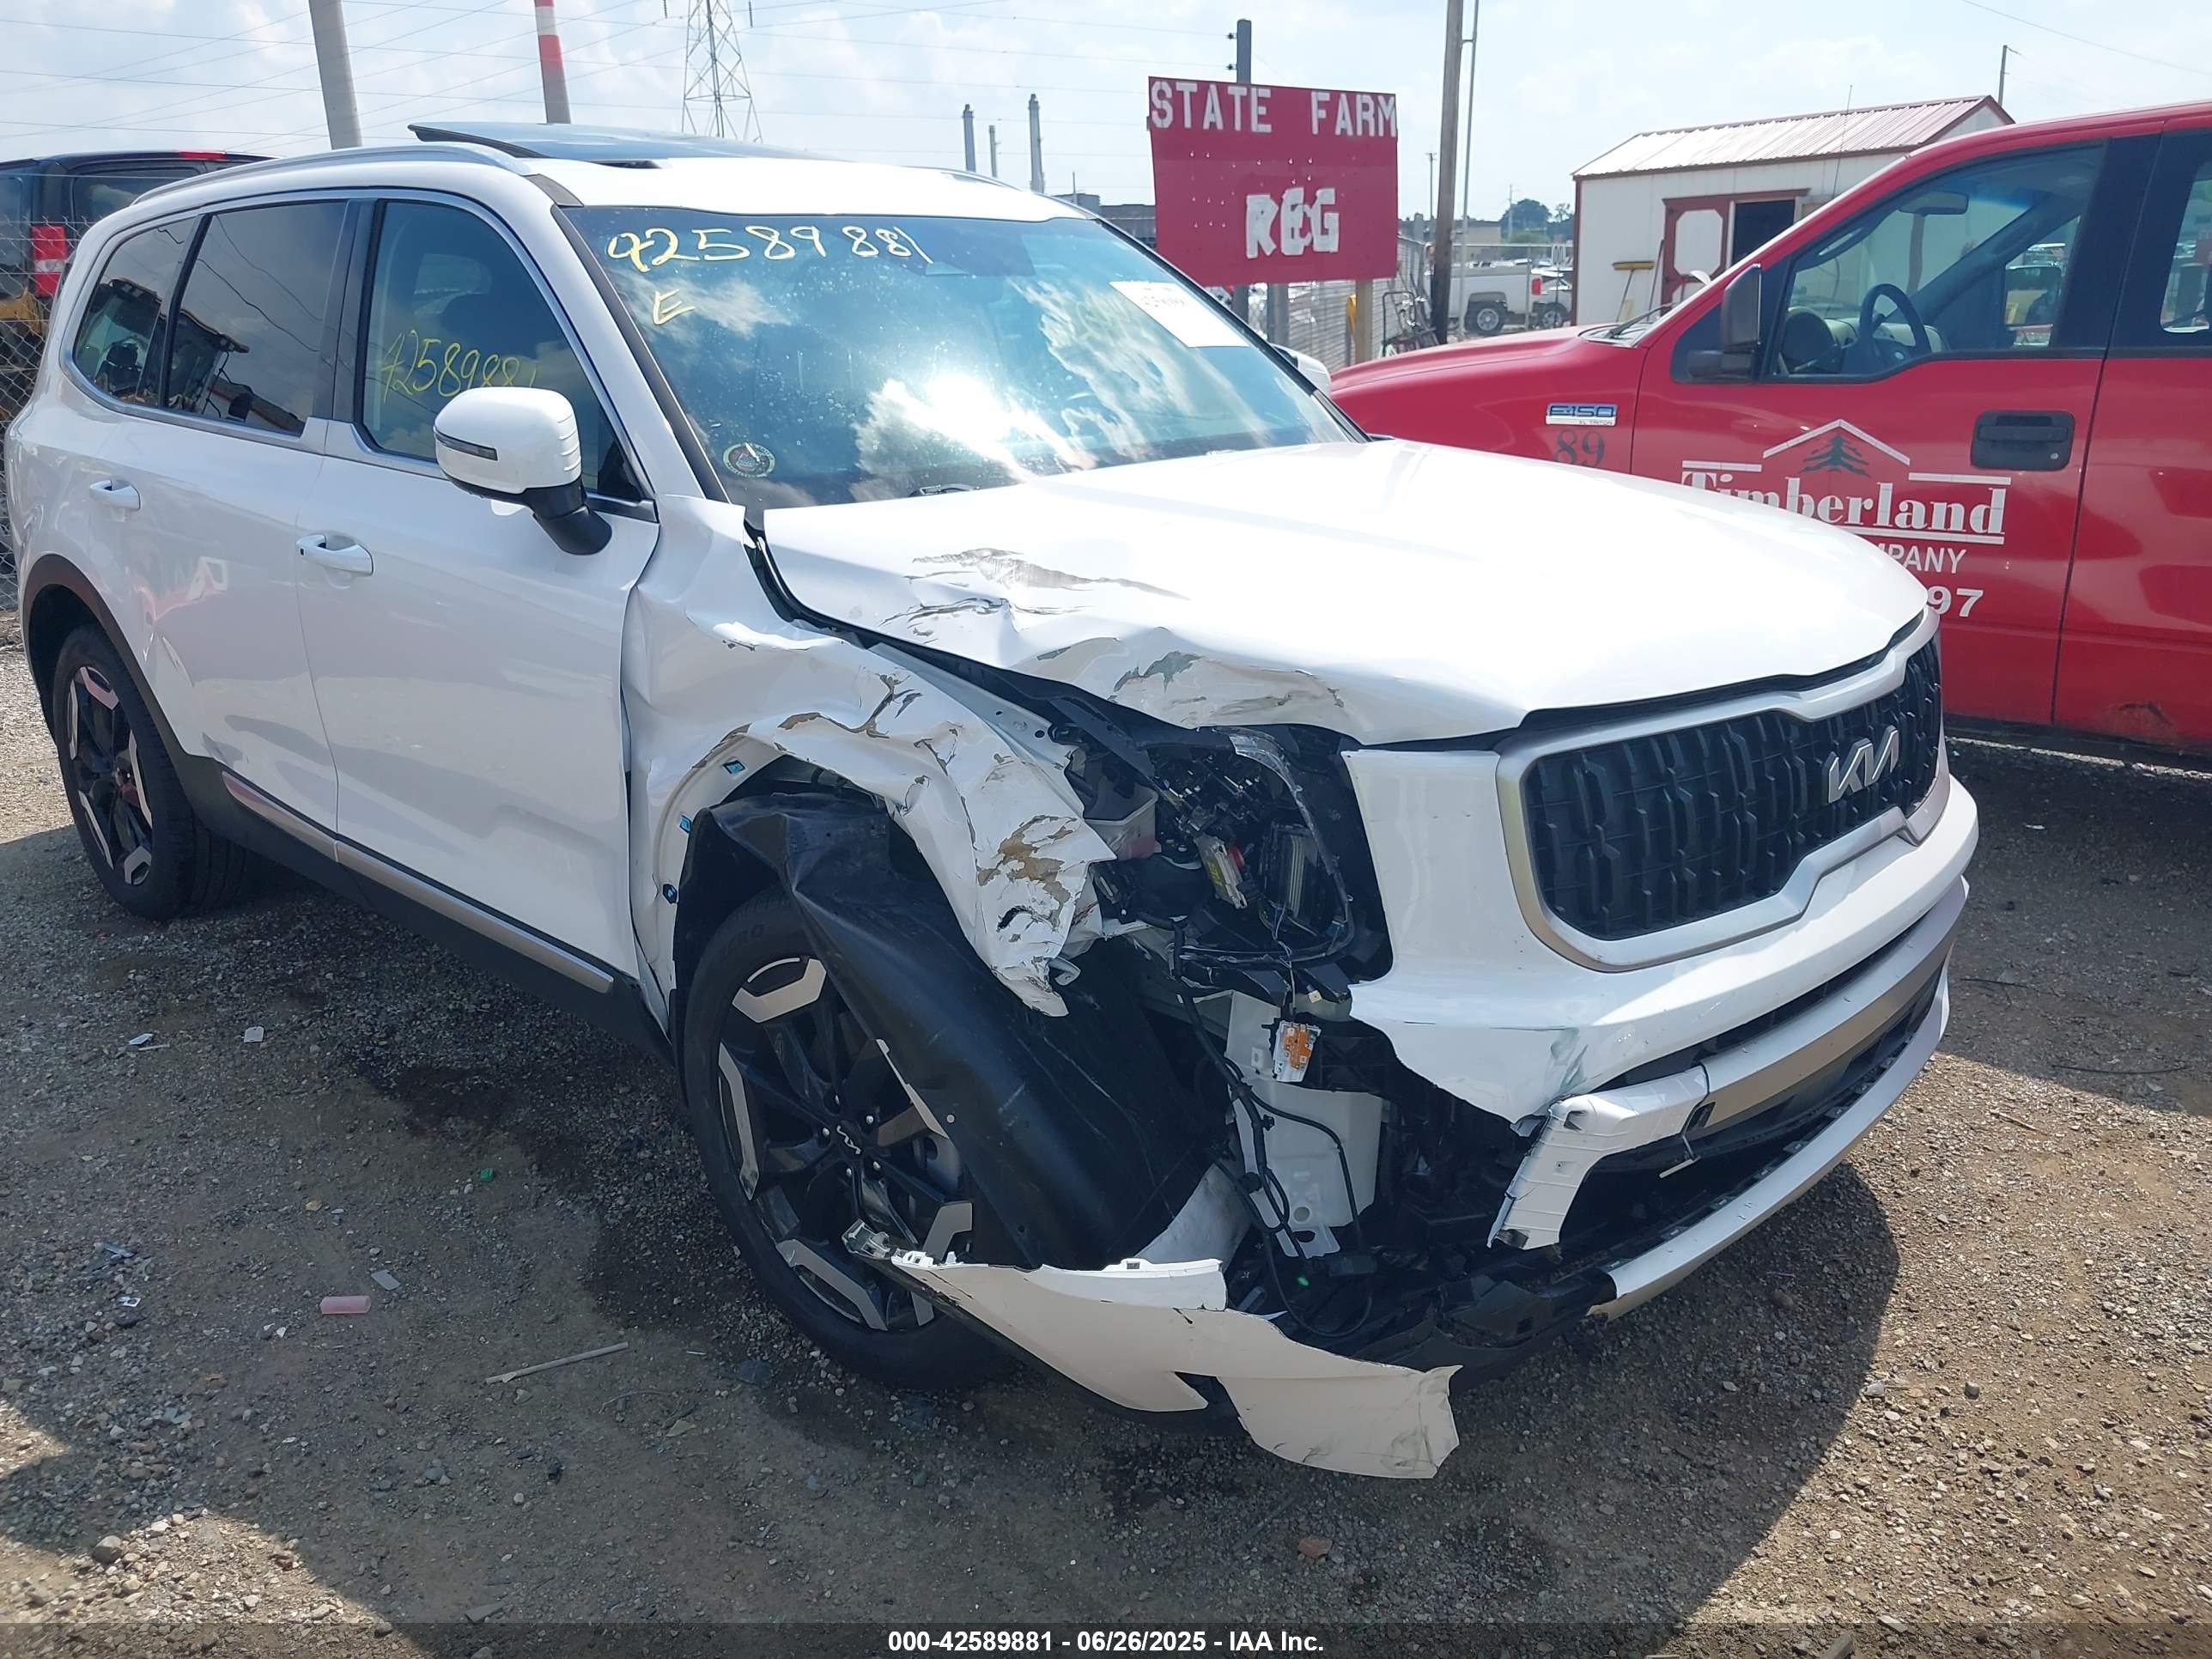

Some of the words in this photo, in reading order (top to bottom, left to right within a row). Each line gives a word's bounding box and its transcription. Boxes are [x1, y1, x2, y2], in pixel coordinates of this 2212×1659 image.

[1151, 81, 1272, 133] STATE
[1310, 91, 1397, 137] FARM
[653, 289, 695, 325] E
[1553, 429, 1606, 468] 89
[1877, 543, 1967, 574] PANY
